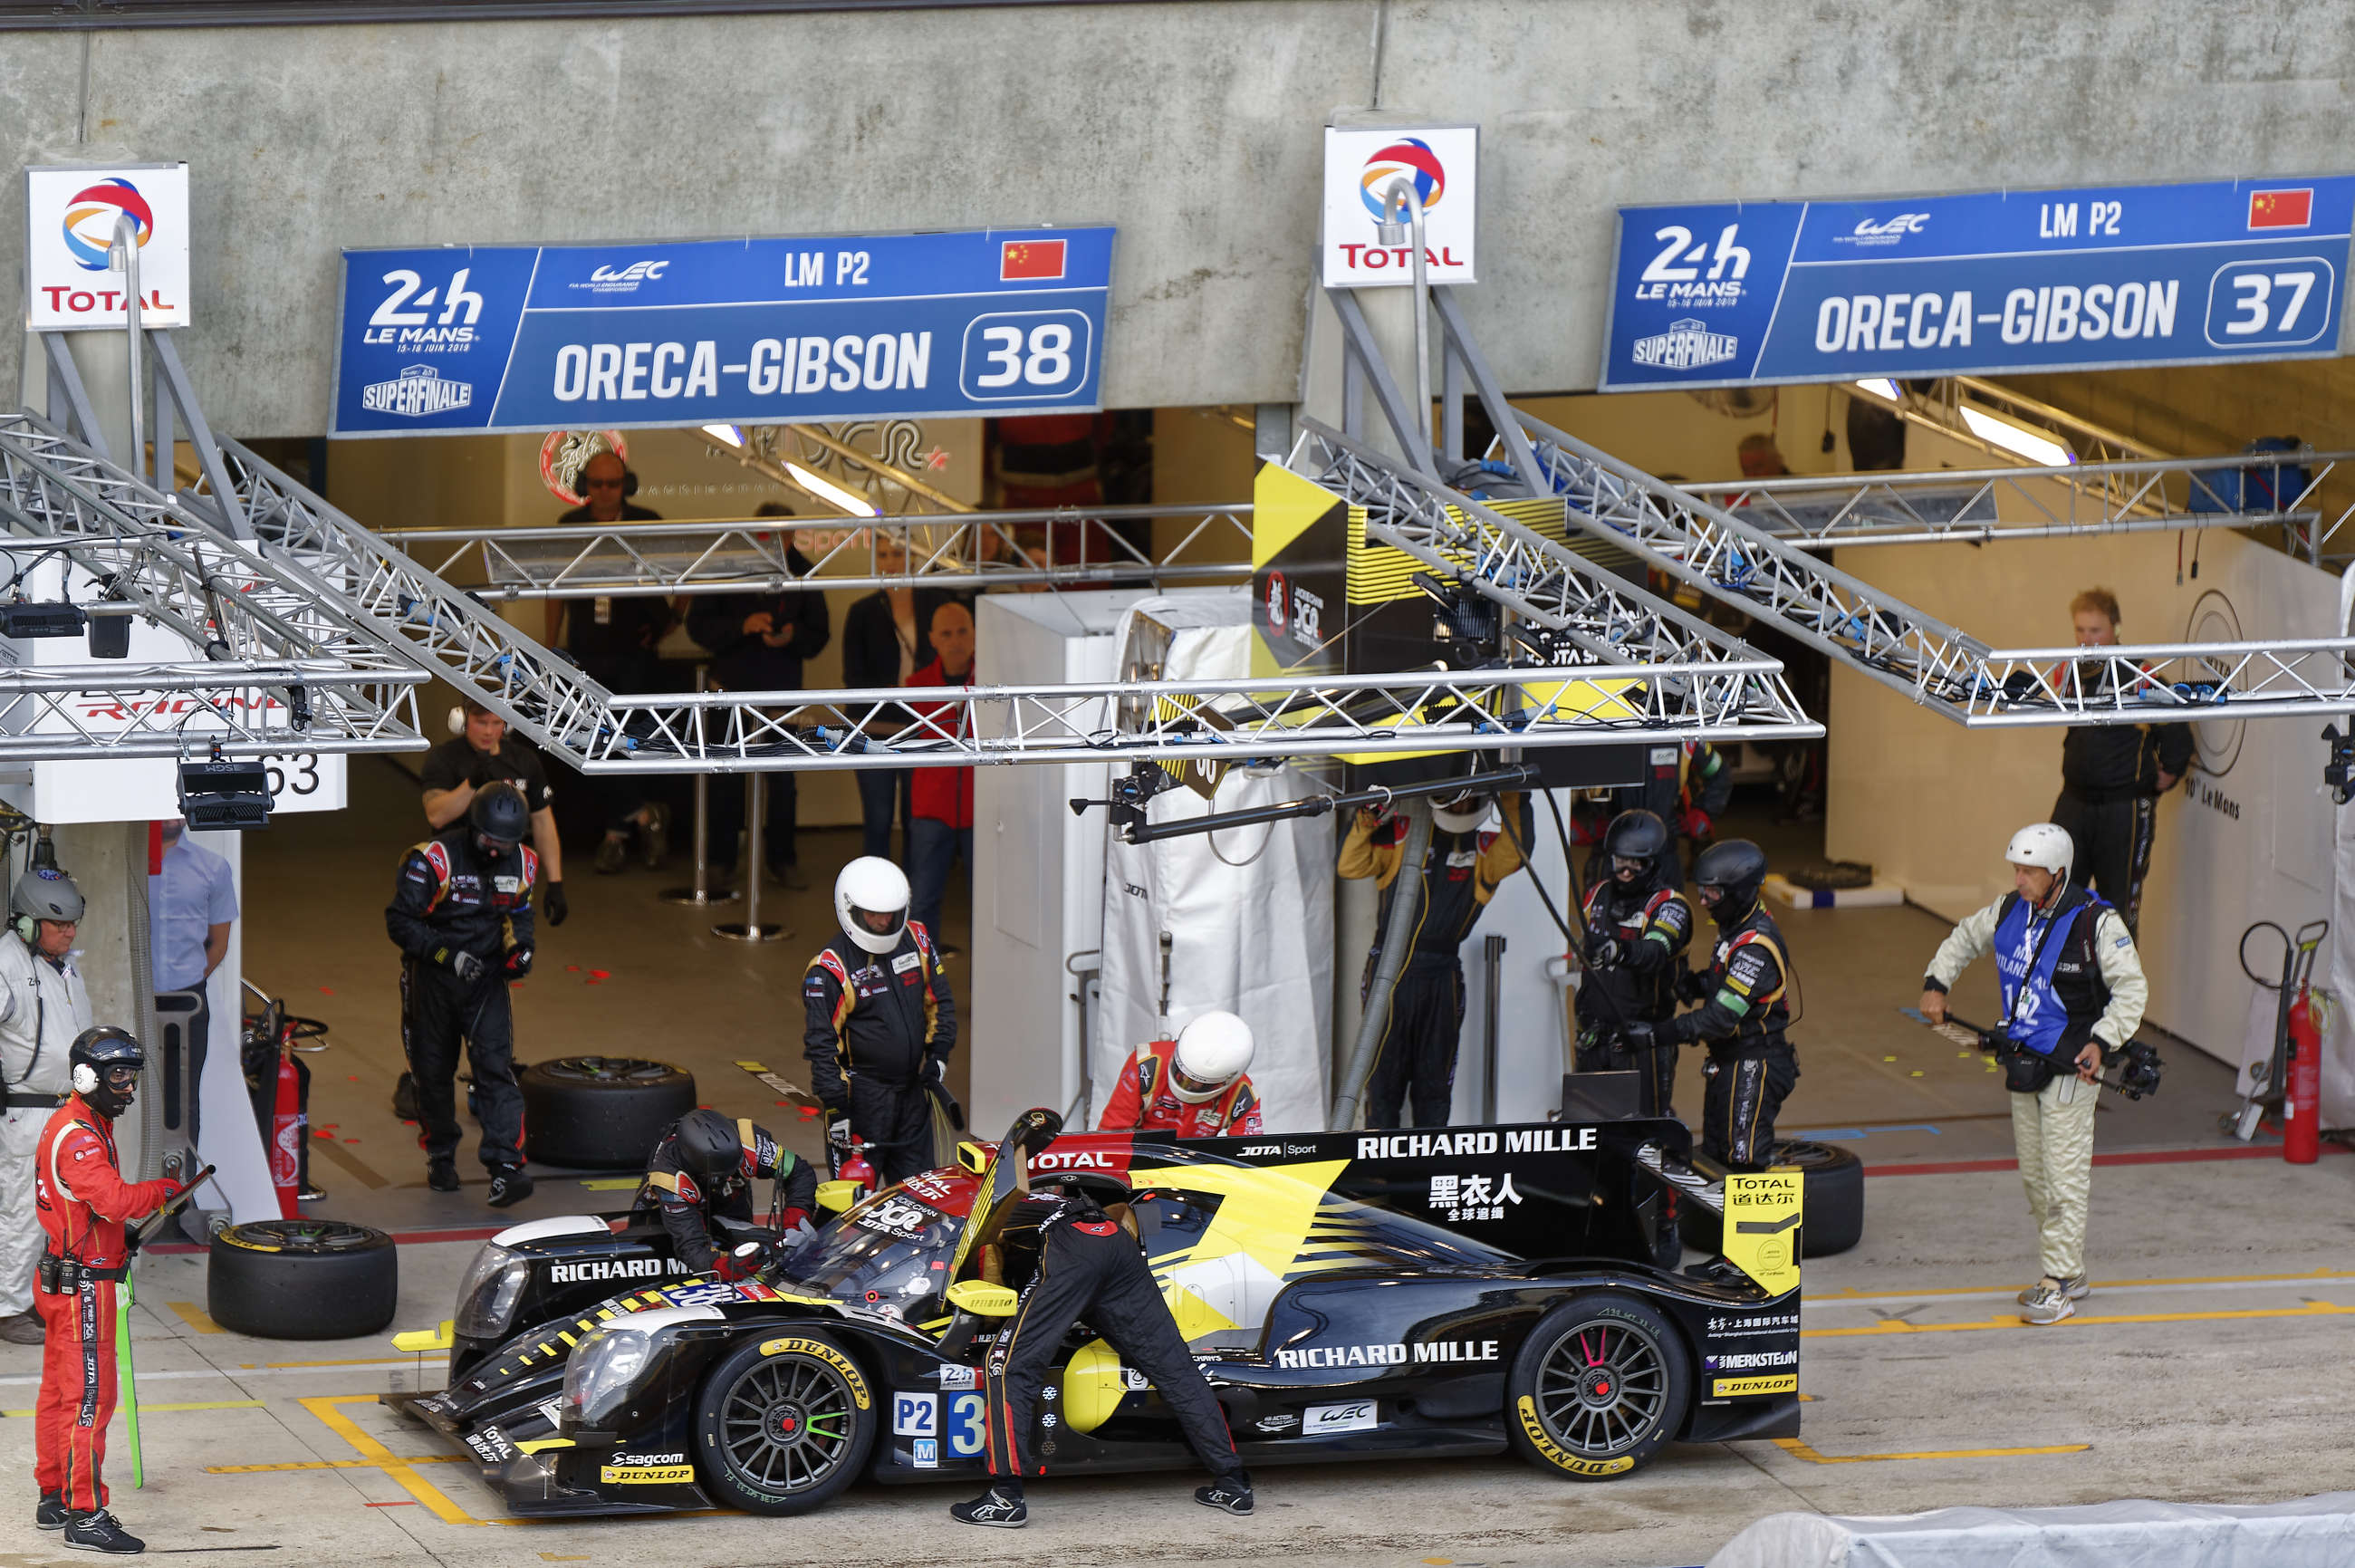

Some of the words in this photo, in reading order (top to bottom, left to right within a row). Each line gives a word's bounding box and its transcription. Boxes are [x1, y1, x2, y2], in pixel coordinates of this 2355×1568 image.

[1854, 213, 1930, 236] WEC
[2040, 203, 2079, 239] LM
[2089, 201, 2123, 236] P2
[1640, 223, 1752, 282] 24h
[591, 260, 669, 282] WEC
[784, 252, 824, 287] LM
[835, 251, 870, 286] P2
[369, 267, 484, 326] 24h
[1635, 283, 1668, 299] LE
[1669, 281, 1741, 298] MANS
[1814, 279, 2180, 353] ORECA-GIBSON
[2225, 271, 2317, 336] 37
[362, 328, 397, 344] LE
[399, 327, 475, 343] MANS
[424, 343, 444, 352] JUIN
[447, 342, 470, 352] 2019
[976, 323, 1072, 389] 38
[1635, 332, 1735, 368] SUPERFINALE
[553, 331, 933, 401] ORECA-GIBSON
[365, 379, 470, 414] SUPERFINALE
[1236, 1146, 1282, 1157] JOTA
[1287, 1144, 1316, 1157] Sport
[1357, 1131, 1498, 1159] RICHARD
[1504, 1128, 1598, 1153] MILLE
[1026, 1151, 1113, 1170] TOTAL
[919, 1169, 952, 1195] OTAL
[1428, 1172, 1524, 1209] 黑衣人
[1733, 1178, 1795, 1189] TOTAL
[914, 1204, 938, 1217] CHAN
[1732, 1193, 1795, 1206] 道达尔
[1447, 1207, 1505, 1222] 全球追缉
[857, 1217, 891, 1233] JOTA
[891, 1227, 925, 1241] Sport
[551, 1258, 662, 1284] RICHARD
[1277, 1343, 1408, 1369] RICHARD
[1413, 1341, 1500, 1363] MILLE
[785, 1340, 867, 1400] DUNLOP
[944, 1368, 973, 1382] 24h
[1729, 1380, 1794, 1391] DUNLOP
[898, 1400, 932, 1430] P2
[1320, 1405, 1370, 1422] WEC
[483, 1426, 513, 1459] TOTAL
[917, 1444, 935, 1459] M
[1521, 1409, 1607, 1474] DUNLOP
[627, 1453, 684, 1467] sagcom
[620, 1469, 690, 1480] DUNLOP
